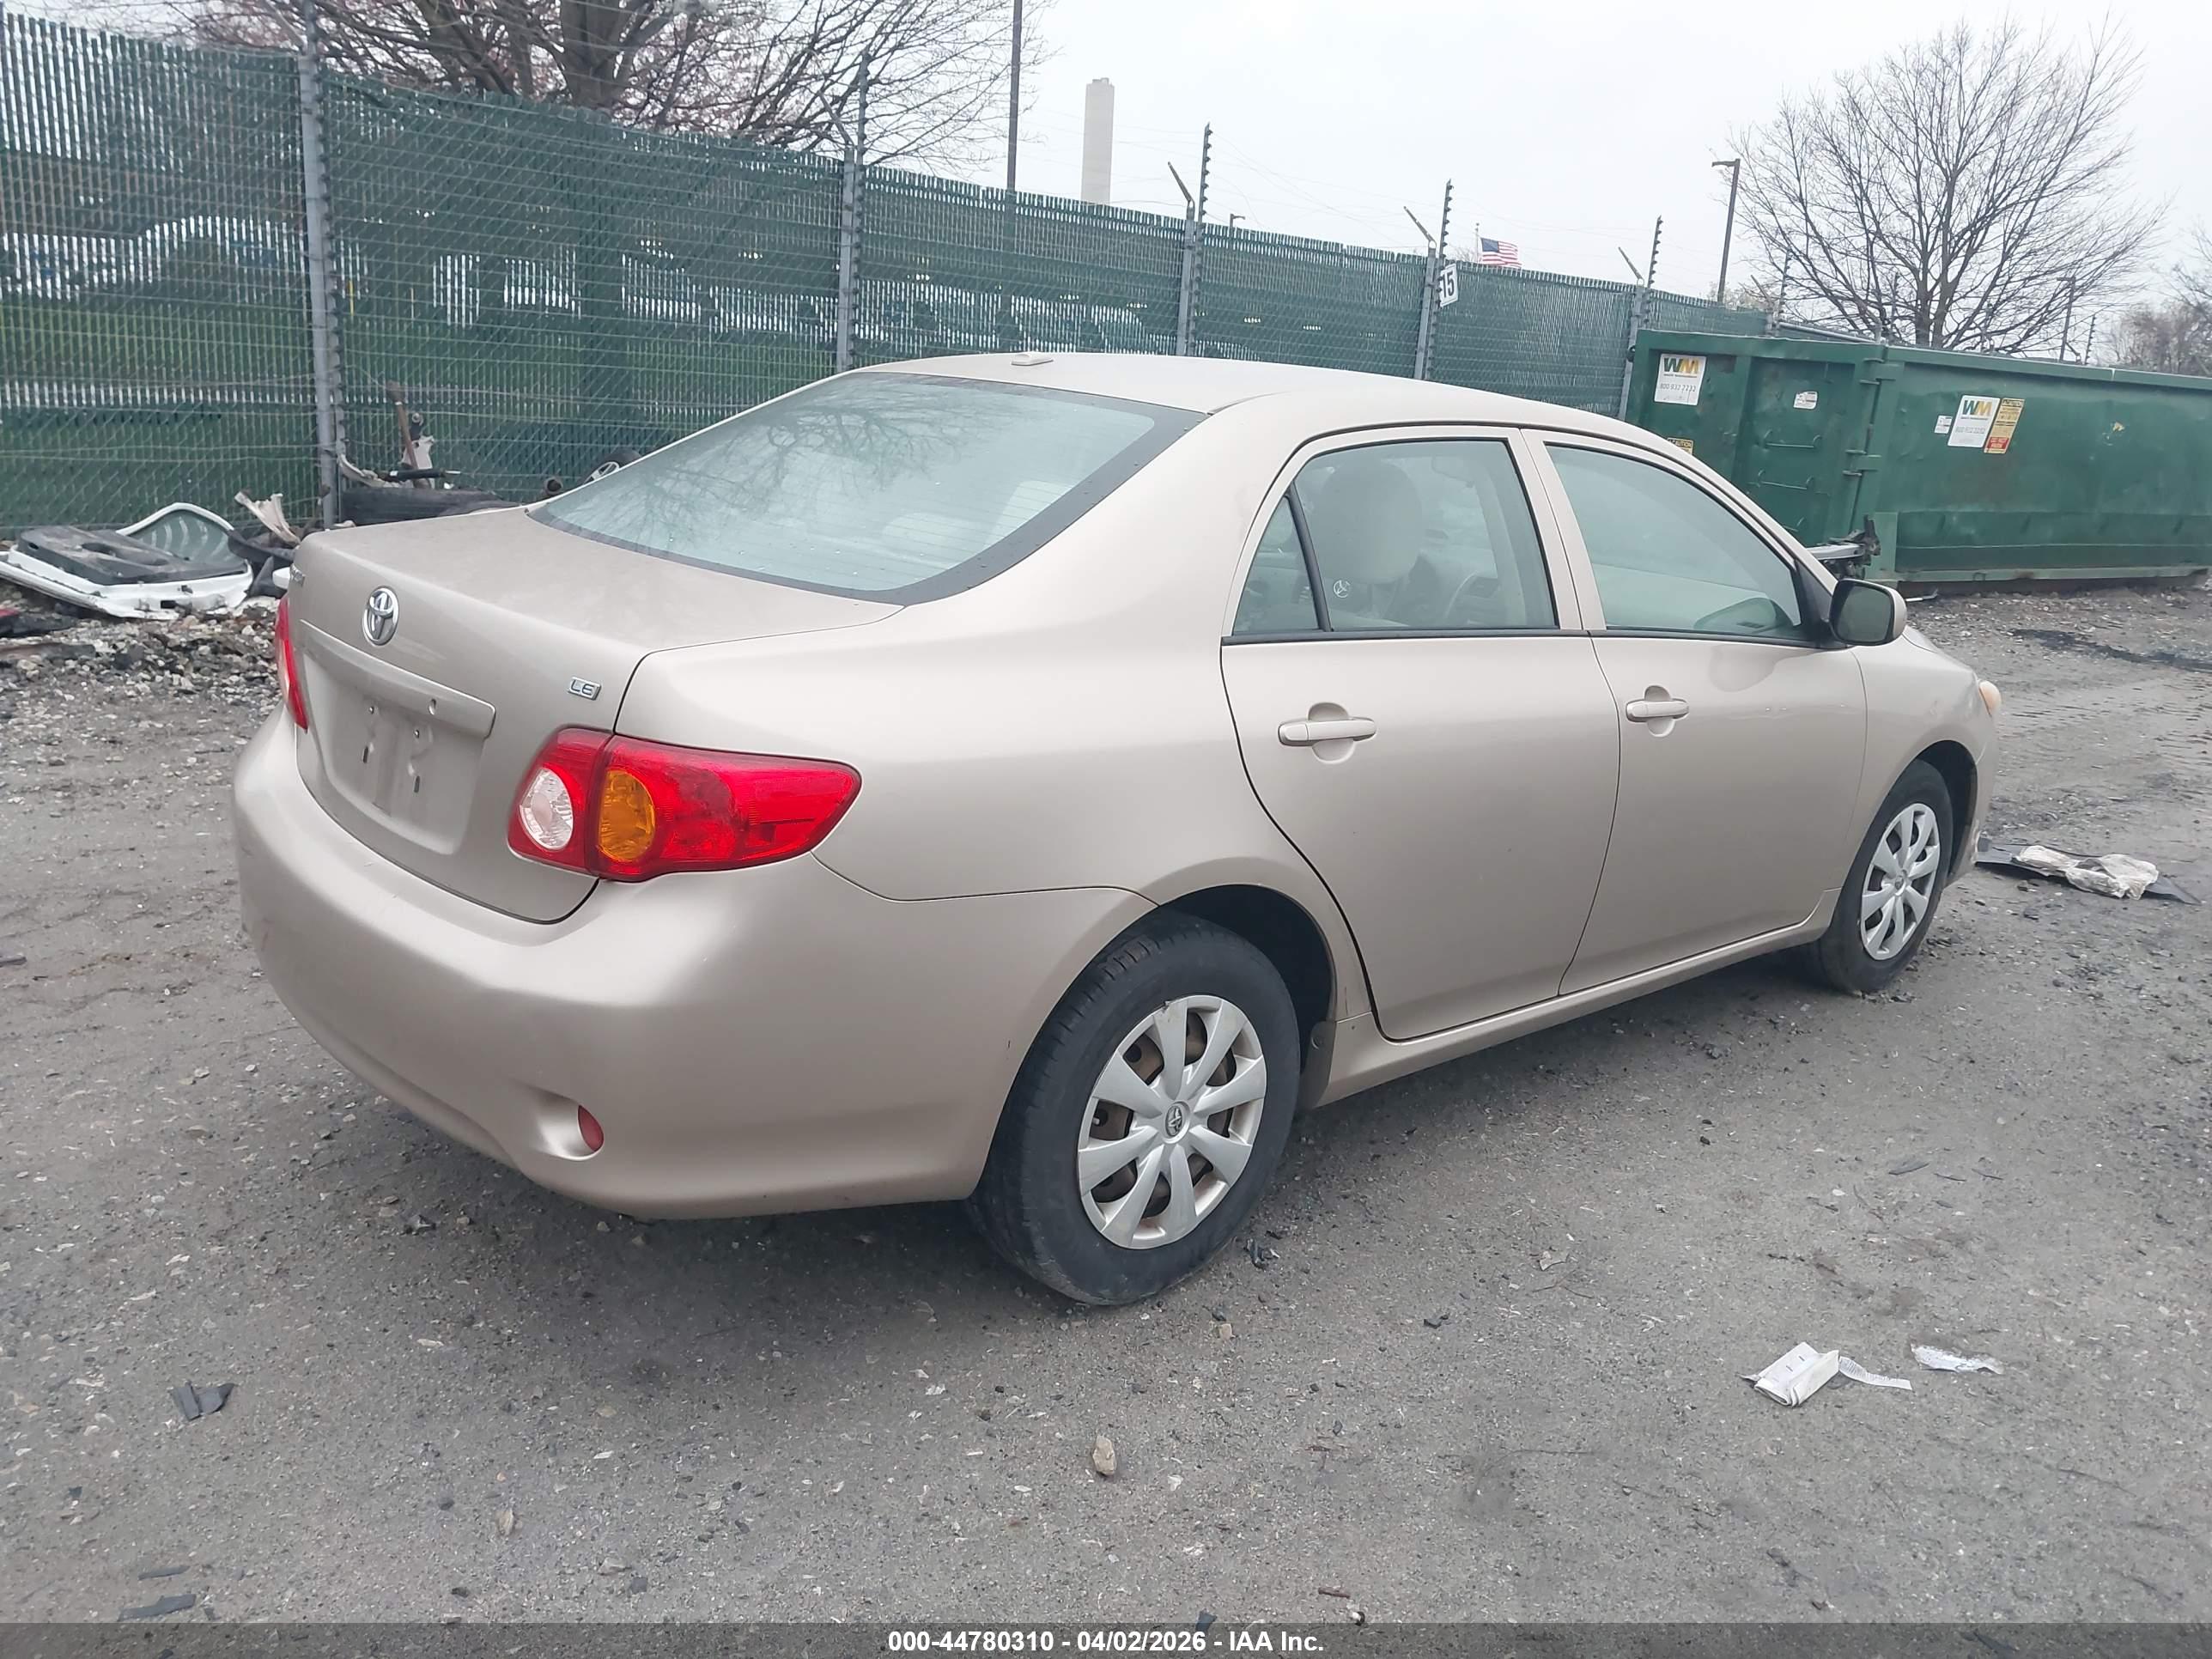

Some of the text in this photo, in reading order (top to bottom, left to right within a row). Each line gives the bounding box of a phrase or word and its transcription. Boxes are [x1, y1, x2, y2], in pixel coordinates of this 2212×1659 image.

[1443, 270, 1455, 298] 15
[1663, 357, 1699, 374] WM
[1962, 399, 1993, 416] WM
[570, 678, 595, 696] LE
